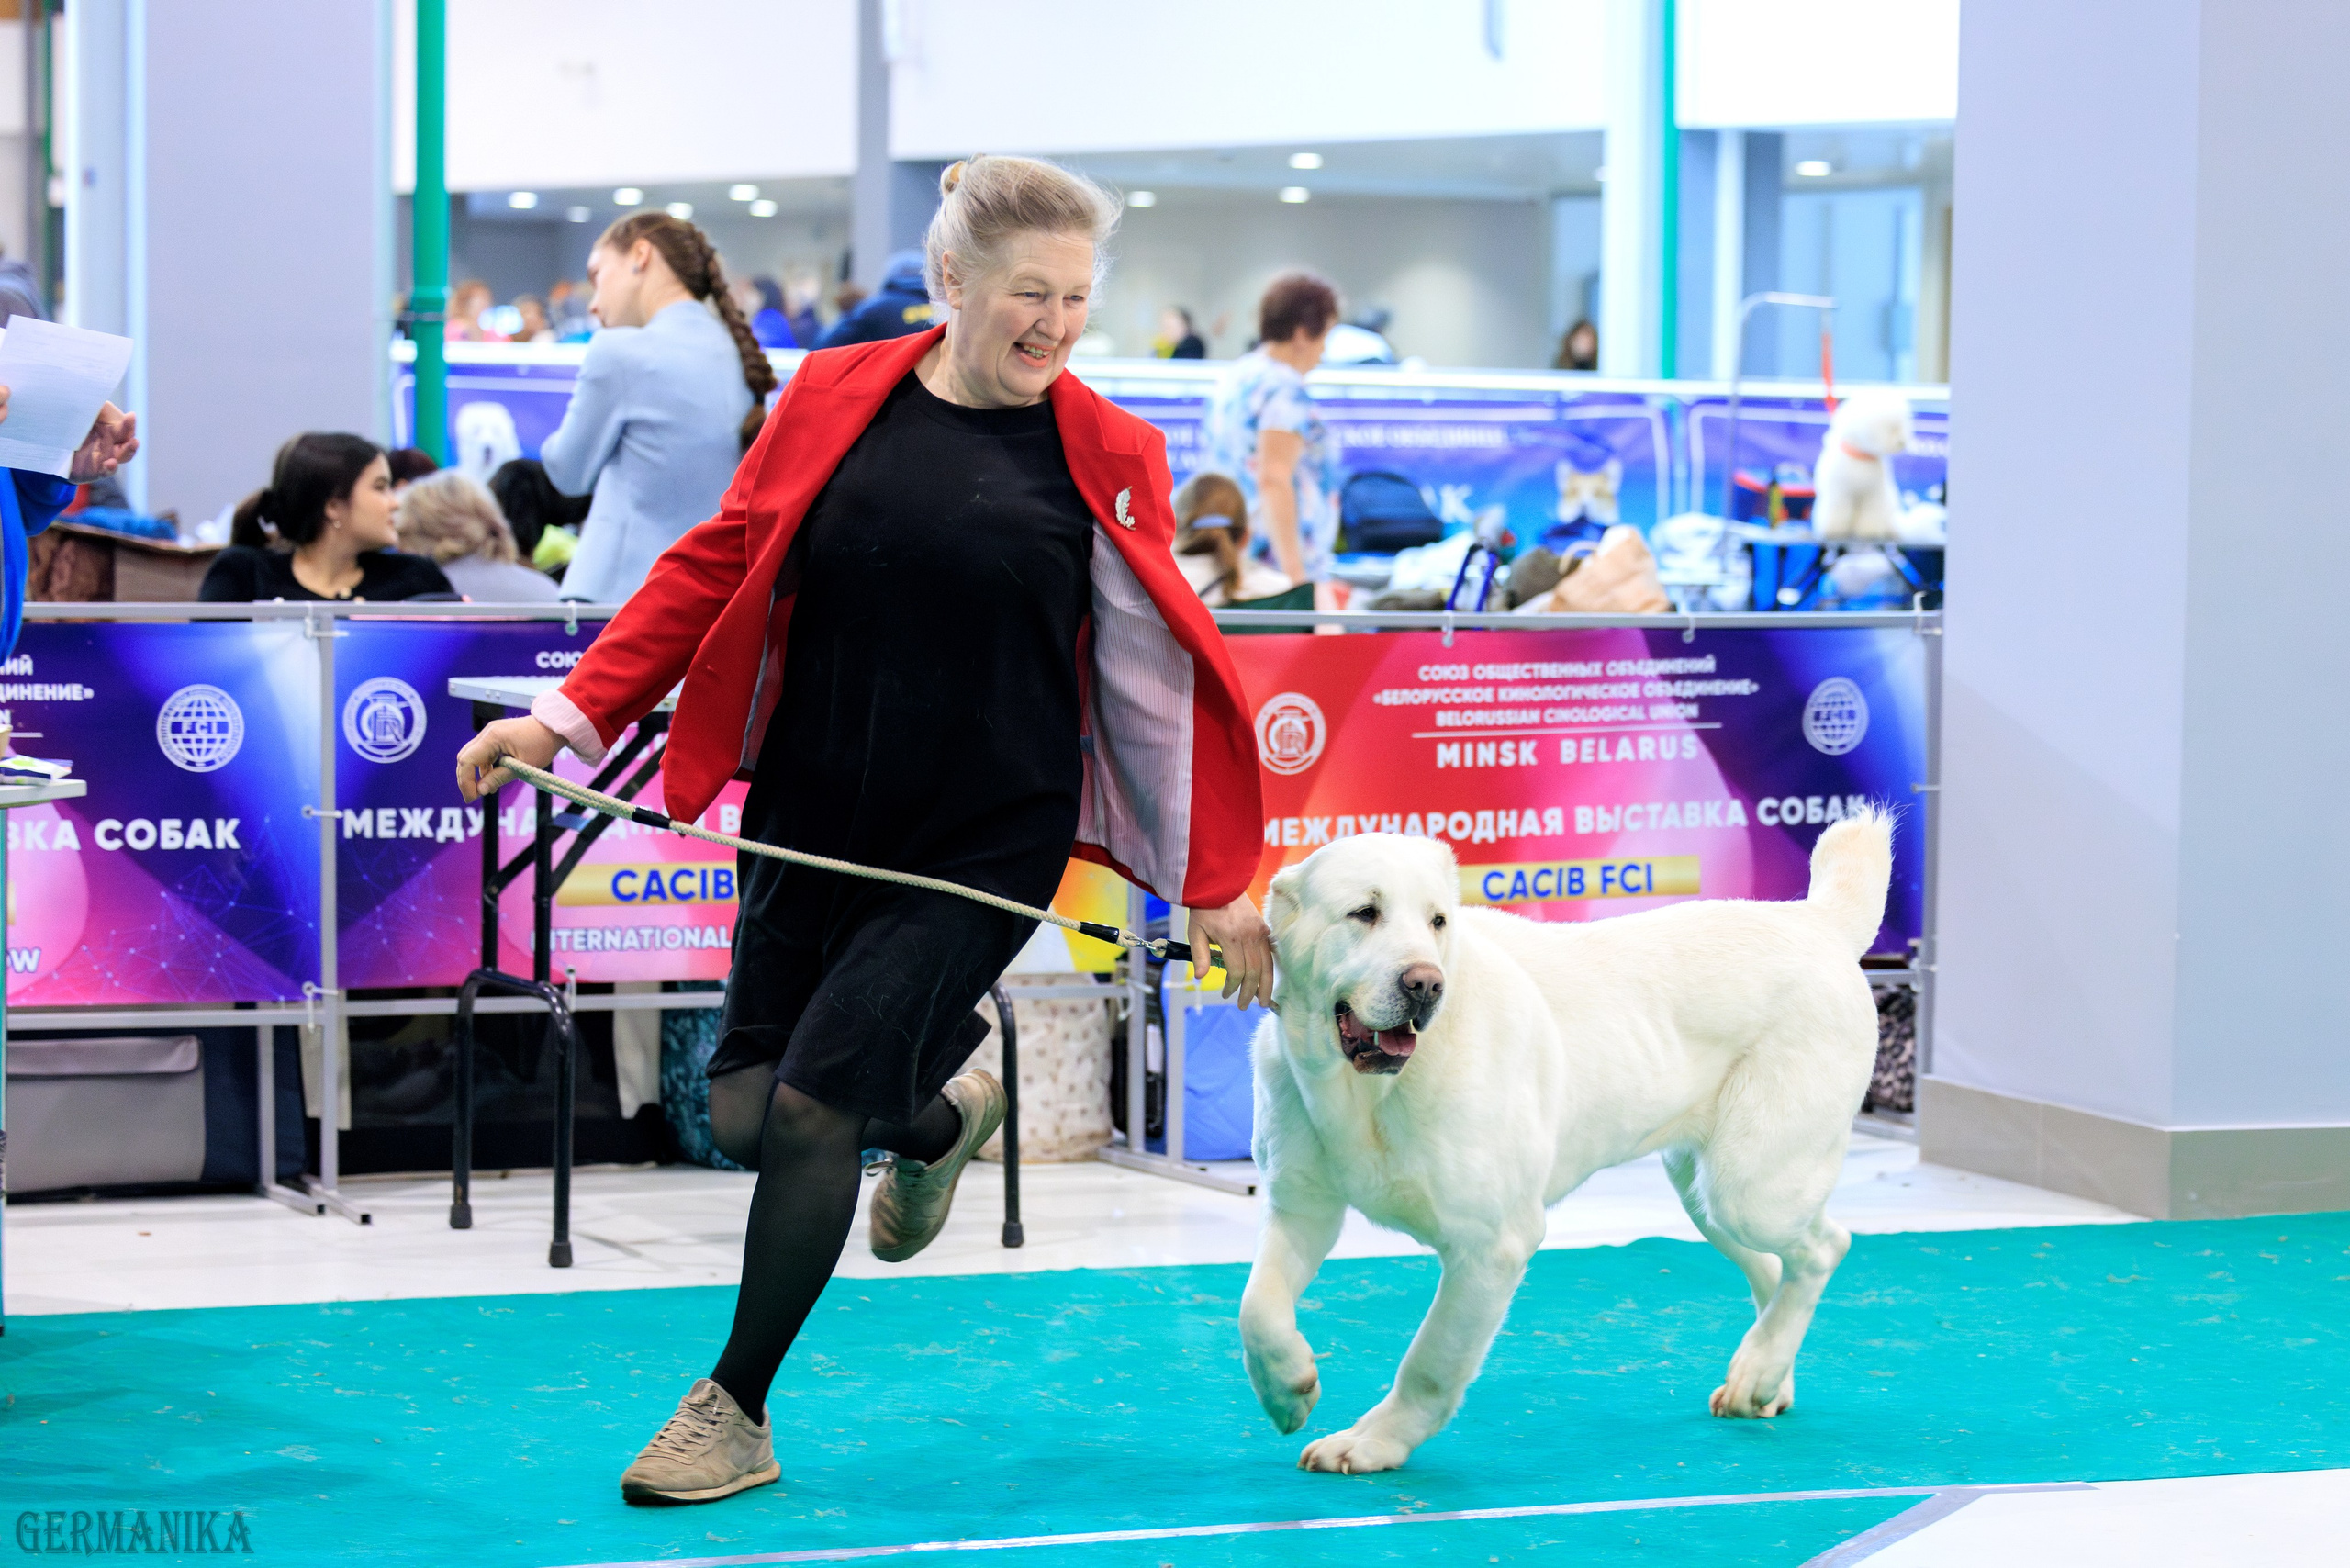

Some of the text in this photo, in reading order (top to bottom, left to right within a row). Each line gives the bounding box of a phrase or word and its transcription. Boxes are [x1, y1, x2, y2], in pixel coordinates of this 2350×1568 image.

[0, 654, 34, 676] ИЙ
[535, 651, 585, 669] СОЮ
[1418, 664, 1469, 681] СОЮЗ
[182, 721, 218, 734] FCI
[1435, 709, 1541, 727] BELORUSSIAN
[1649, 702, 1699, 721] UNION
[1436, 734, 1698, 768] MINSK BELARUS
[1574, 798, 1748, 834] ВЫСТАВКА
[1757, 794, 1866, 826] СОБАК
[94, 818, 241, 851] СОБАК
[611, 868, 735, 902] CACIB
[1483, 862, 1654, 902] CACIB FCI
